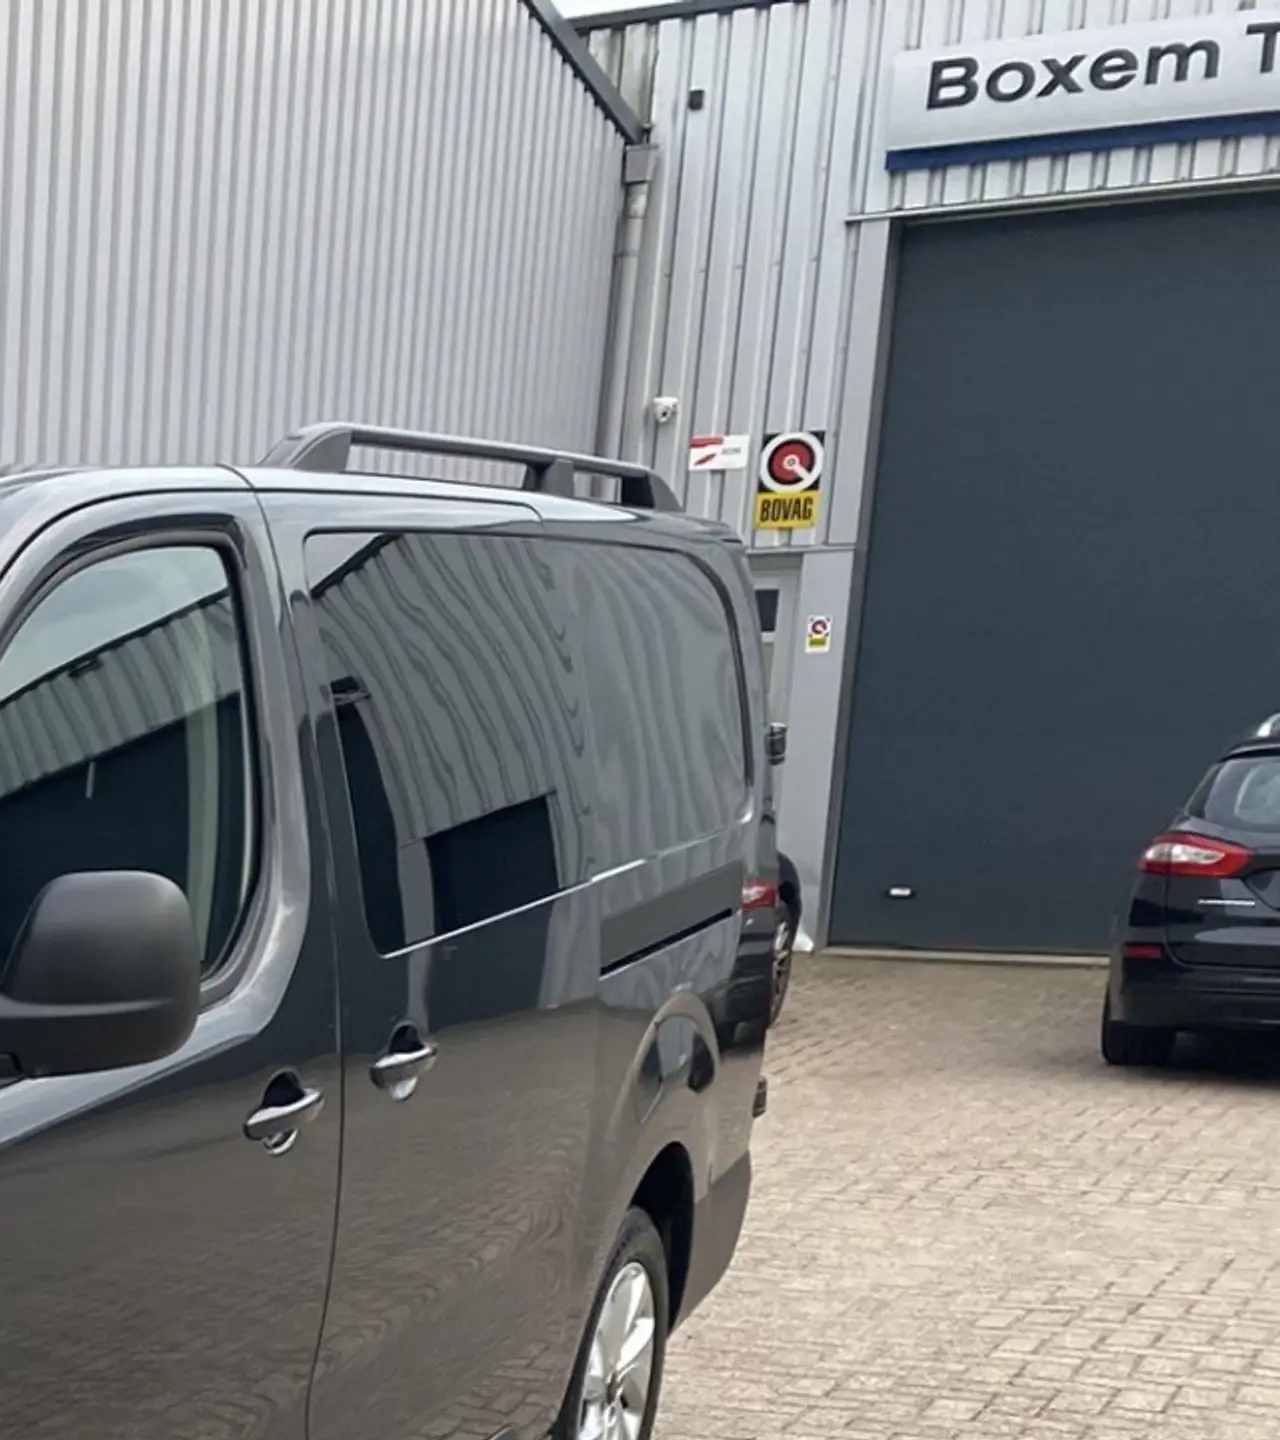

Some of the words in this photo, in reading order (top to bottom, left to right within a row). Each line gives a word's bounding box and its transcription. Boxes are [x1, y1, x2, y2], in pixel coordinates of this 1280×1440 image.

[926, 39, 1221, 110] Boxem
[1246, 21, 1280, 74] T
[759, 496, 814, 522] BOVAG
